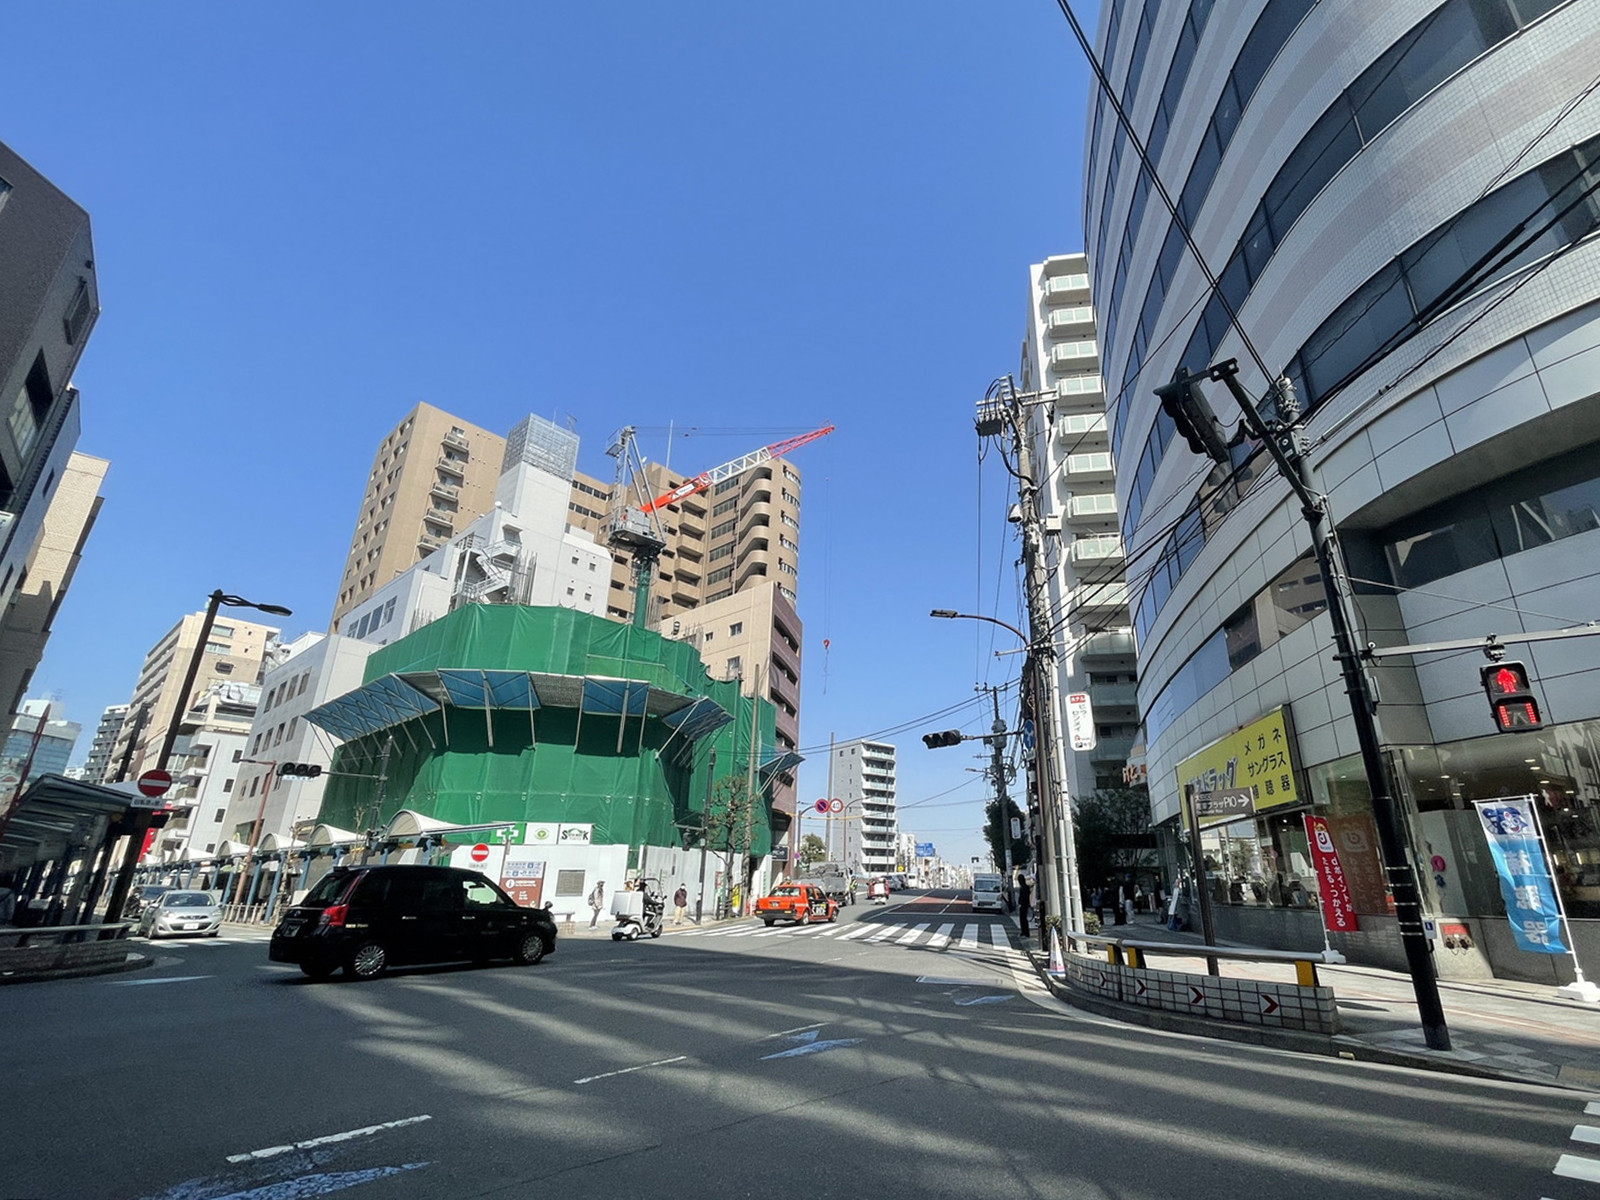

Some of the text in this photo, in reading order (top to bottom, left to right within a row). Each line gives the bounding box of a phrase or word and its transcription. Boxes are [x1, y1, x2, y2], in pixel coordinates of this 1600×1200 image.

[1244, 727, 1282, 756] メガネ
[1187, 757, 1238, 790] ネドラッグ
[1247, 751, 1287, 778] サングラス
[1321, 856, 1346, 927] たまる・つかえる
[1331, 856, 1352, 912] dポイントが
